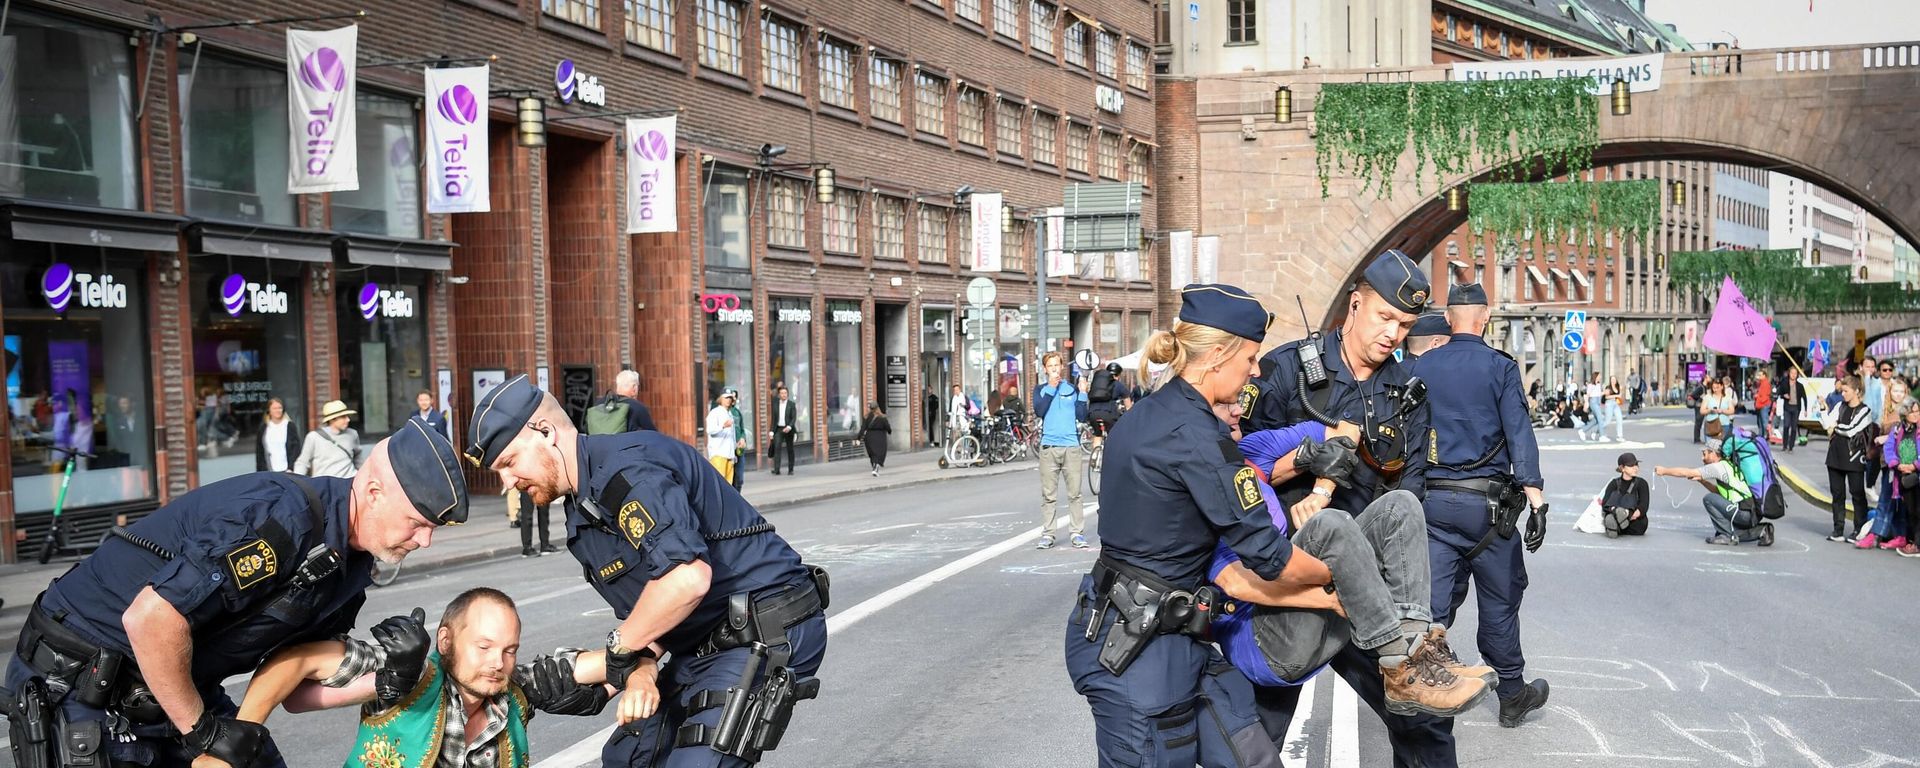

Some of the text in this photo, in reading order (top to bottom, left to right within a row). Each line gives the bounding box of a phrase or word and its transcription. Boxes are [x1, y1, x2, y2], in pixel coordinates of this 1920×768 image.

[576, 72, 605, 106] Telia
[308, 102, 334, 175] Telia
[444, 133, 468, 198] Telia
[640, 169, 660, 221] Telia
[75, 273, 127, 308] Telia
[247, 282, 288, 313] Telia
[379, 290, 413, 317] Telia
[718, 308, 753, 325] smarteyes
[778, 308, 811, 325] smarteyes
[833, 309, 862, 325] smarteyes
[1236, 469, 1255, 485] POLIS
[620, 502, 638, 528] POLIS
[257, 542, 274, 573] POLIS
[600, 560, 624, 578] POLIS
